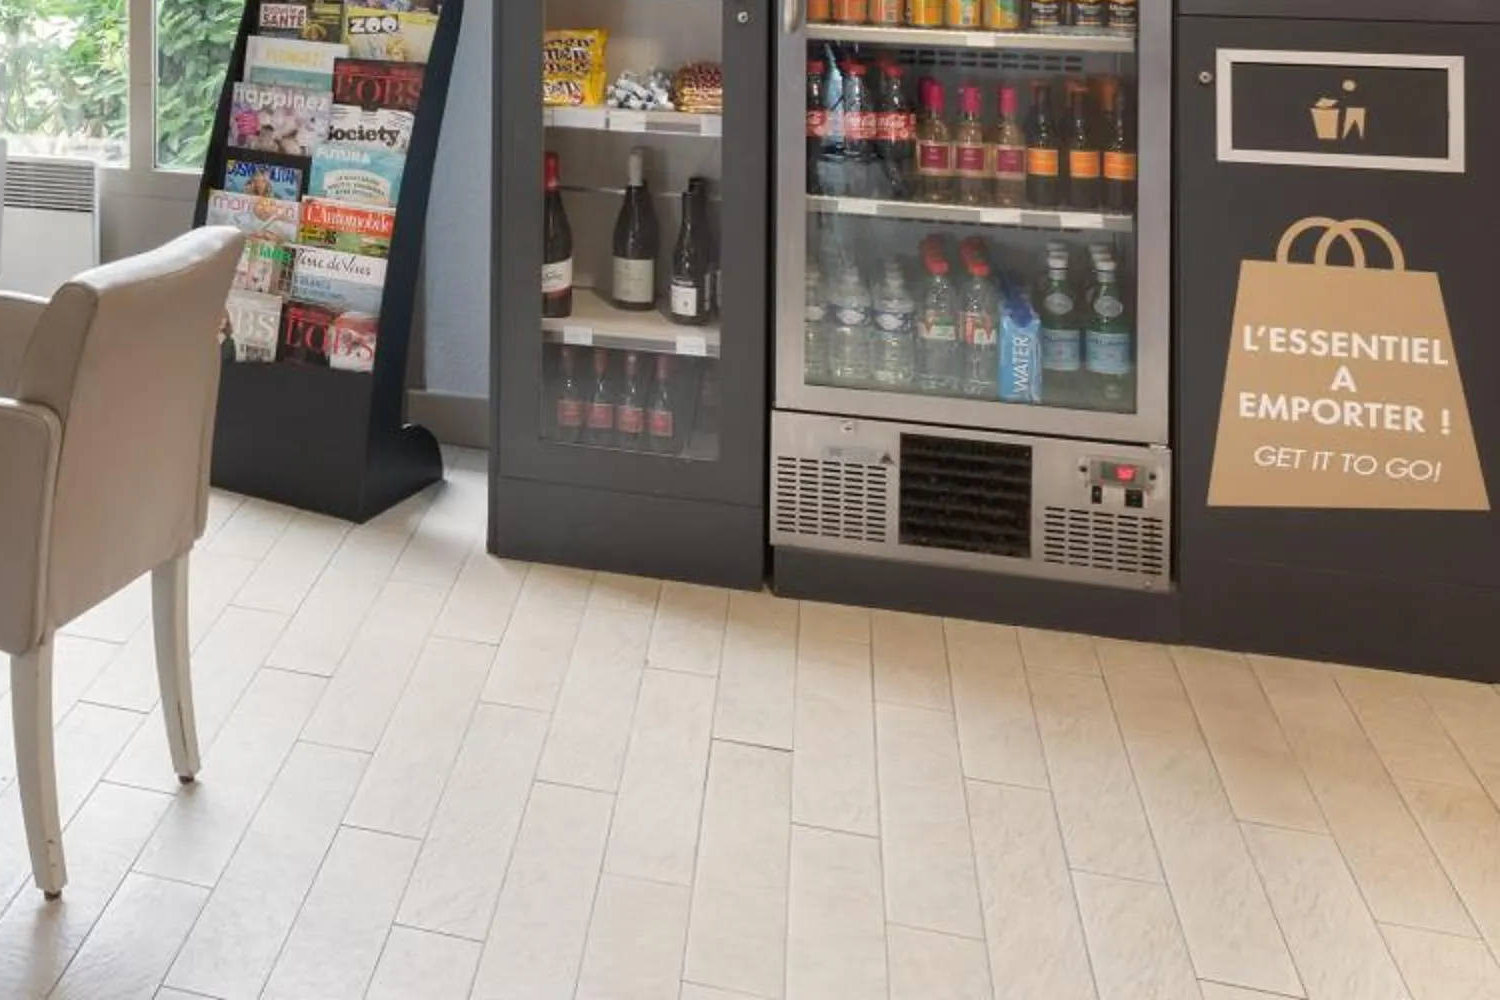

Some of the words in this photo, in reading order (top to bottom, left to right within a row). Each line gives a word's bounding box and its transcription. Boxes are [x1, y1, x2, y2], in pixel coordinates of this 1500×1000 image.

[1011, 335, 1029, 393] WATER
[1243, 324, 1449, 365] L'ESSENTIEL
[1330, 365, 1358, 393] A
[1238, 391, 1426, 433] EMPORTER
[1440, 408, 1452, 436] !
[1253, 445, 1307, 469] GET
[1311, 451, 1334, 472] IT
[1340, 452, 1379, 475] TO
[1385, 456, 1443, 483] GO!
